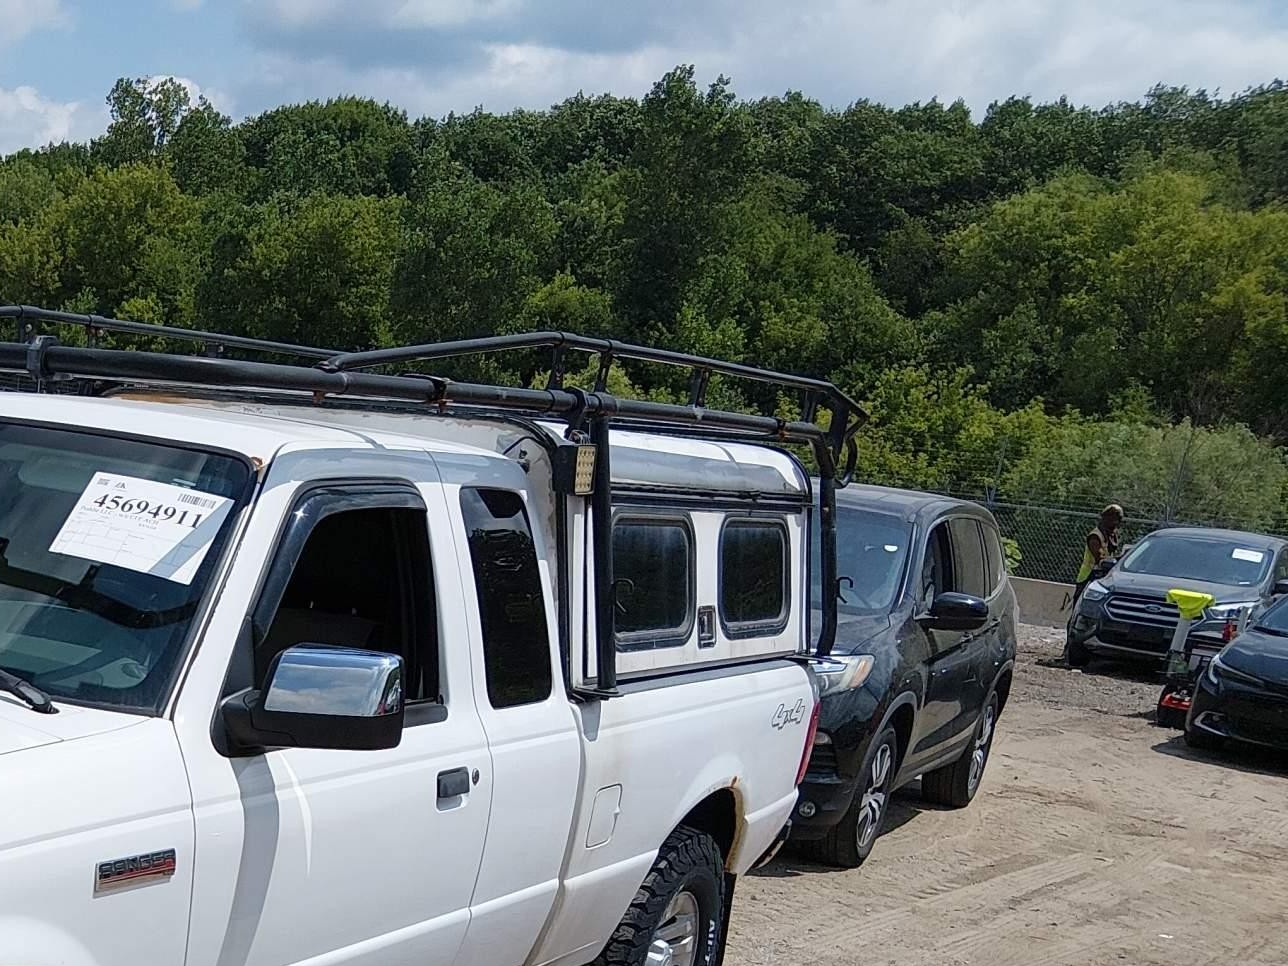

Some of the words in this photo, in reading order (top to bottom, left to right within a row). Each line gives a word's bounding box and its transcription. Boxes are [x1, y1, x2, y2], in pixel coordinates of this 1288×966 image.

[93, 492, 203, 530] 45694911
[772, 698, 805, 730] 4x4
[98, 850, 176, 881] RANGER
